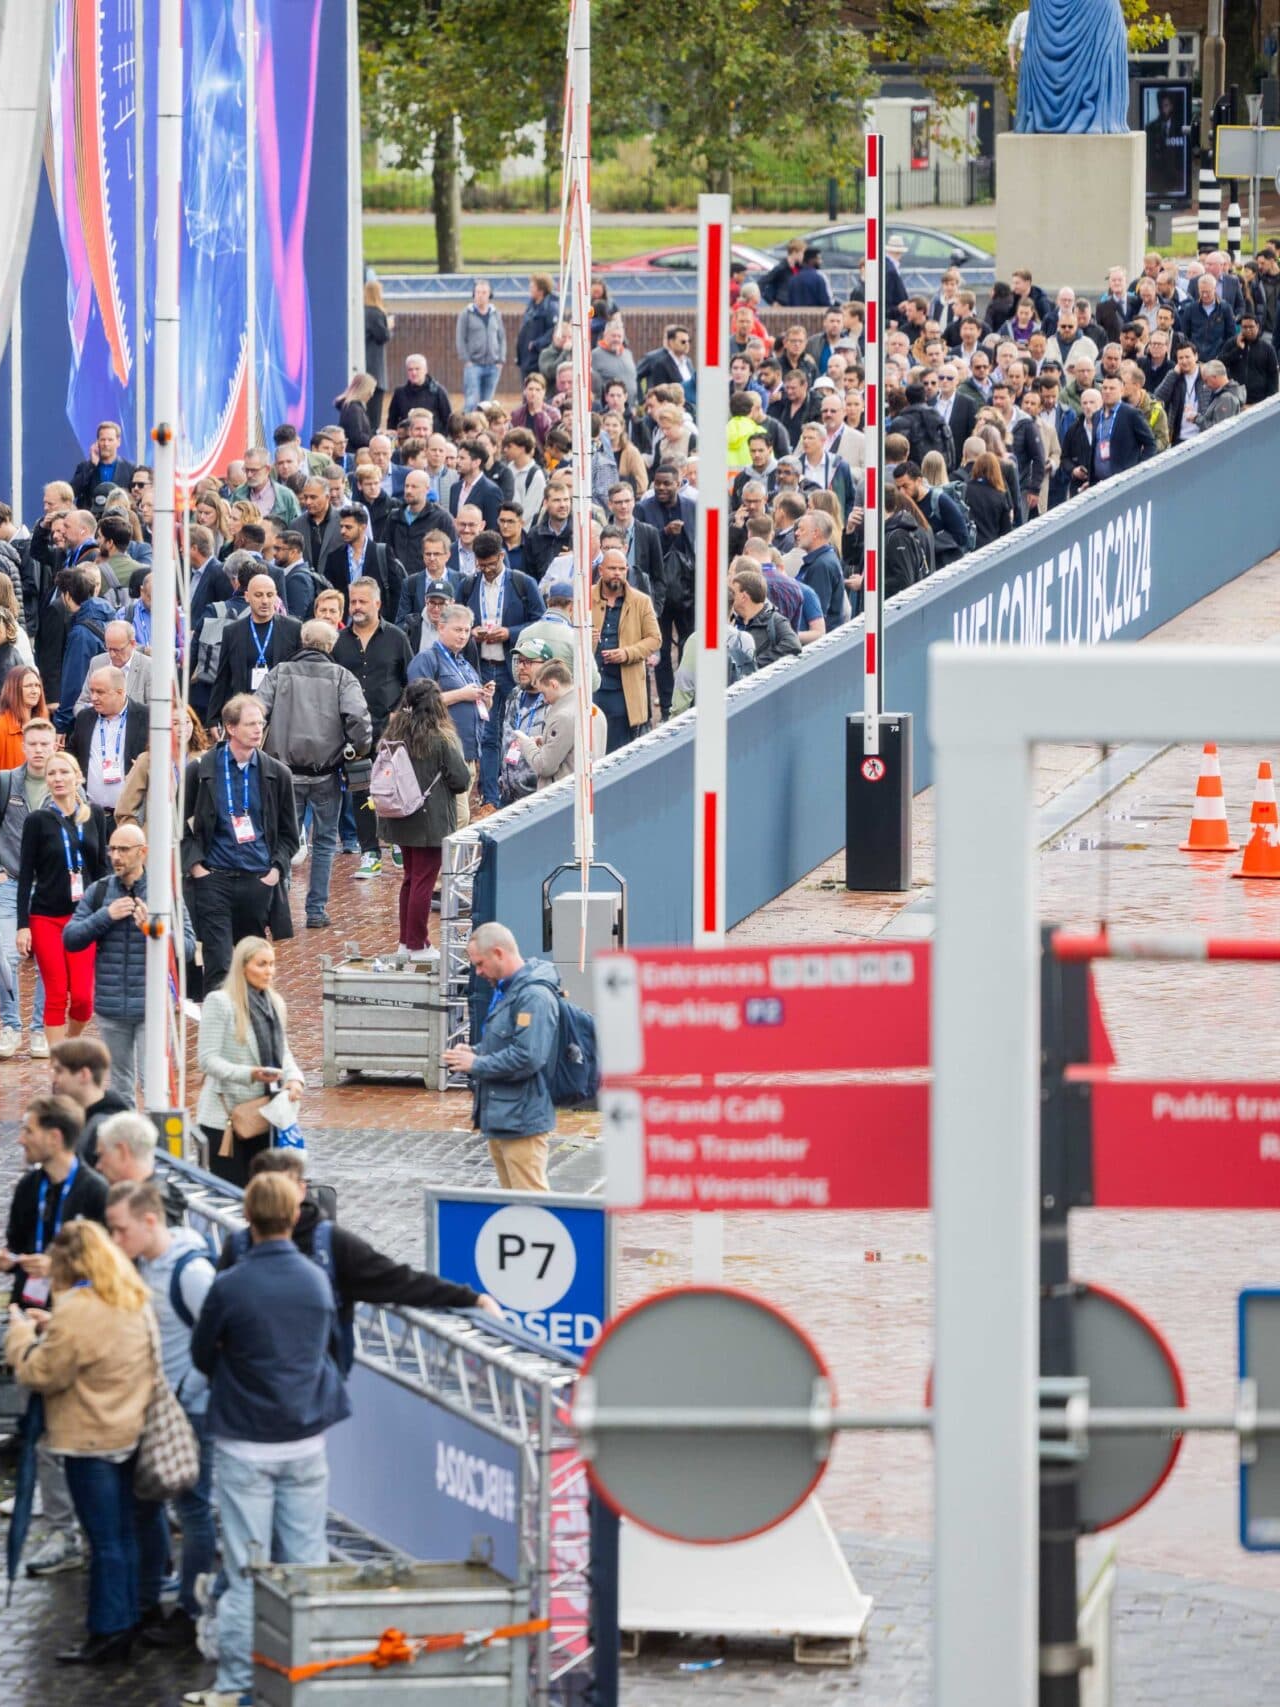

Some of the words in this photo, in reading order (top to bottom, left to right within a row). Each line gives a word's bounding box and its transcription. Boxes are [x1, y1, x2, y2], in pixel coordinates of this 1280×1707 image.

[642, 961, 765, 989] Entrances
[643, 998, 740, 1029] Parking
[647, 1096, 720, 1123] Grand
[724, 1094, 784, 1123] Café
[1152, 1091, 1232, 1121] Public
[648, 1135, 694, 1161] The
[699, 1134, 809, 1162] Traveller
[696, 1172, 830, 1205] Vereniging
[498, 1234, 555, 1279] P7
